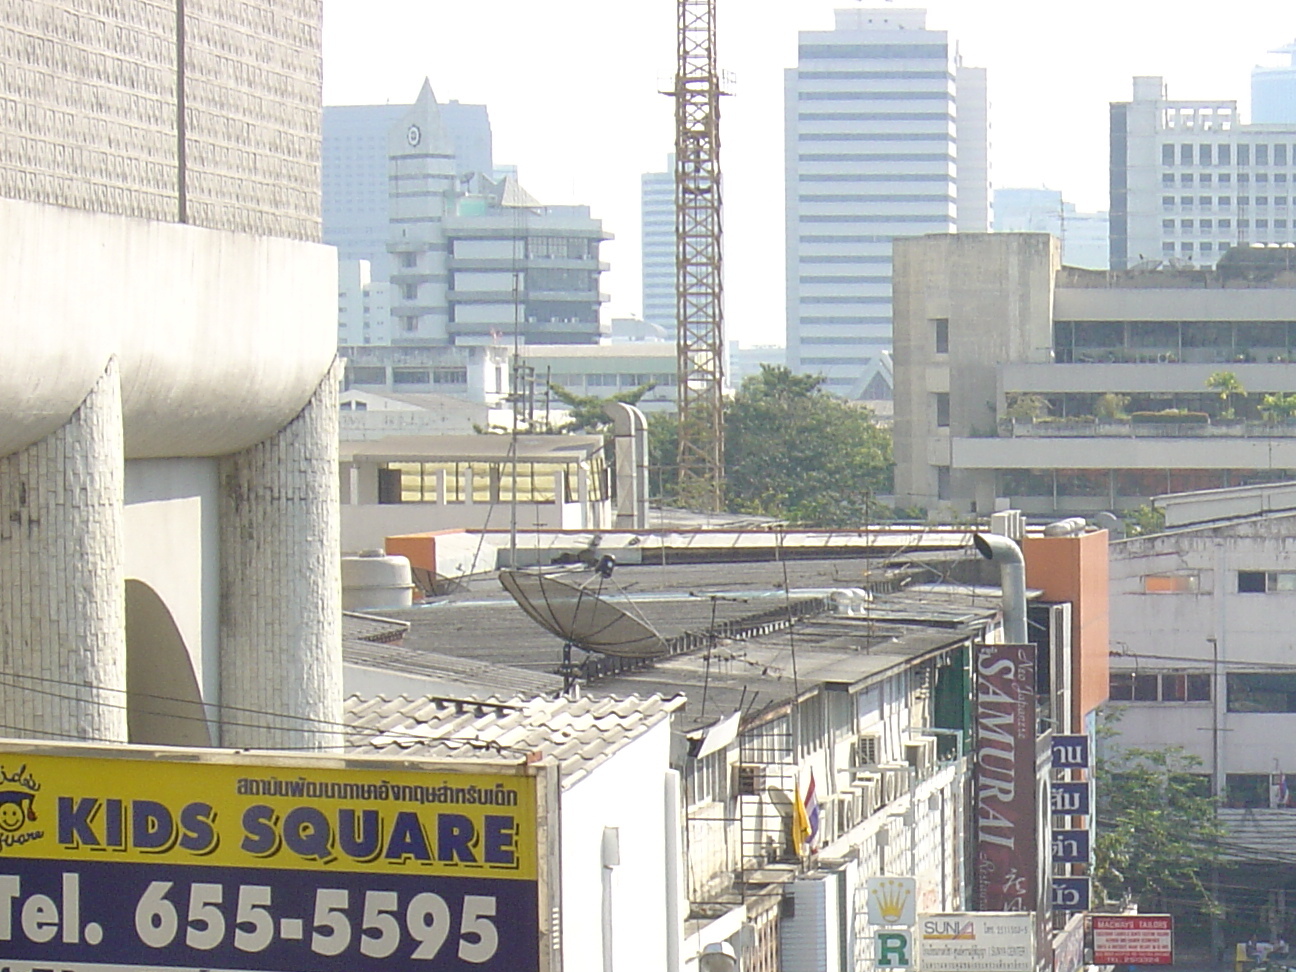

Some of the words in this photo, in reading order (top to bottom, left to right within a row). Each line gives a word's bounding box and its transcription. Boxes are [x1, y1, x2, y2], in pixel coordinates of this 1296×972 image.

[978, 653, 1015, 850] SAMURAI
[57, 796, 222, 856] KIDS
[241, 803, 520, 871] SQUARE
[134, 879, 500, 964] 655-5595
